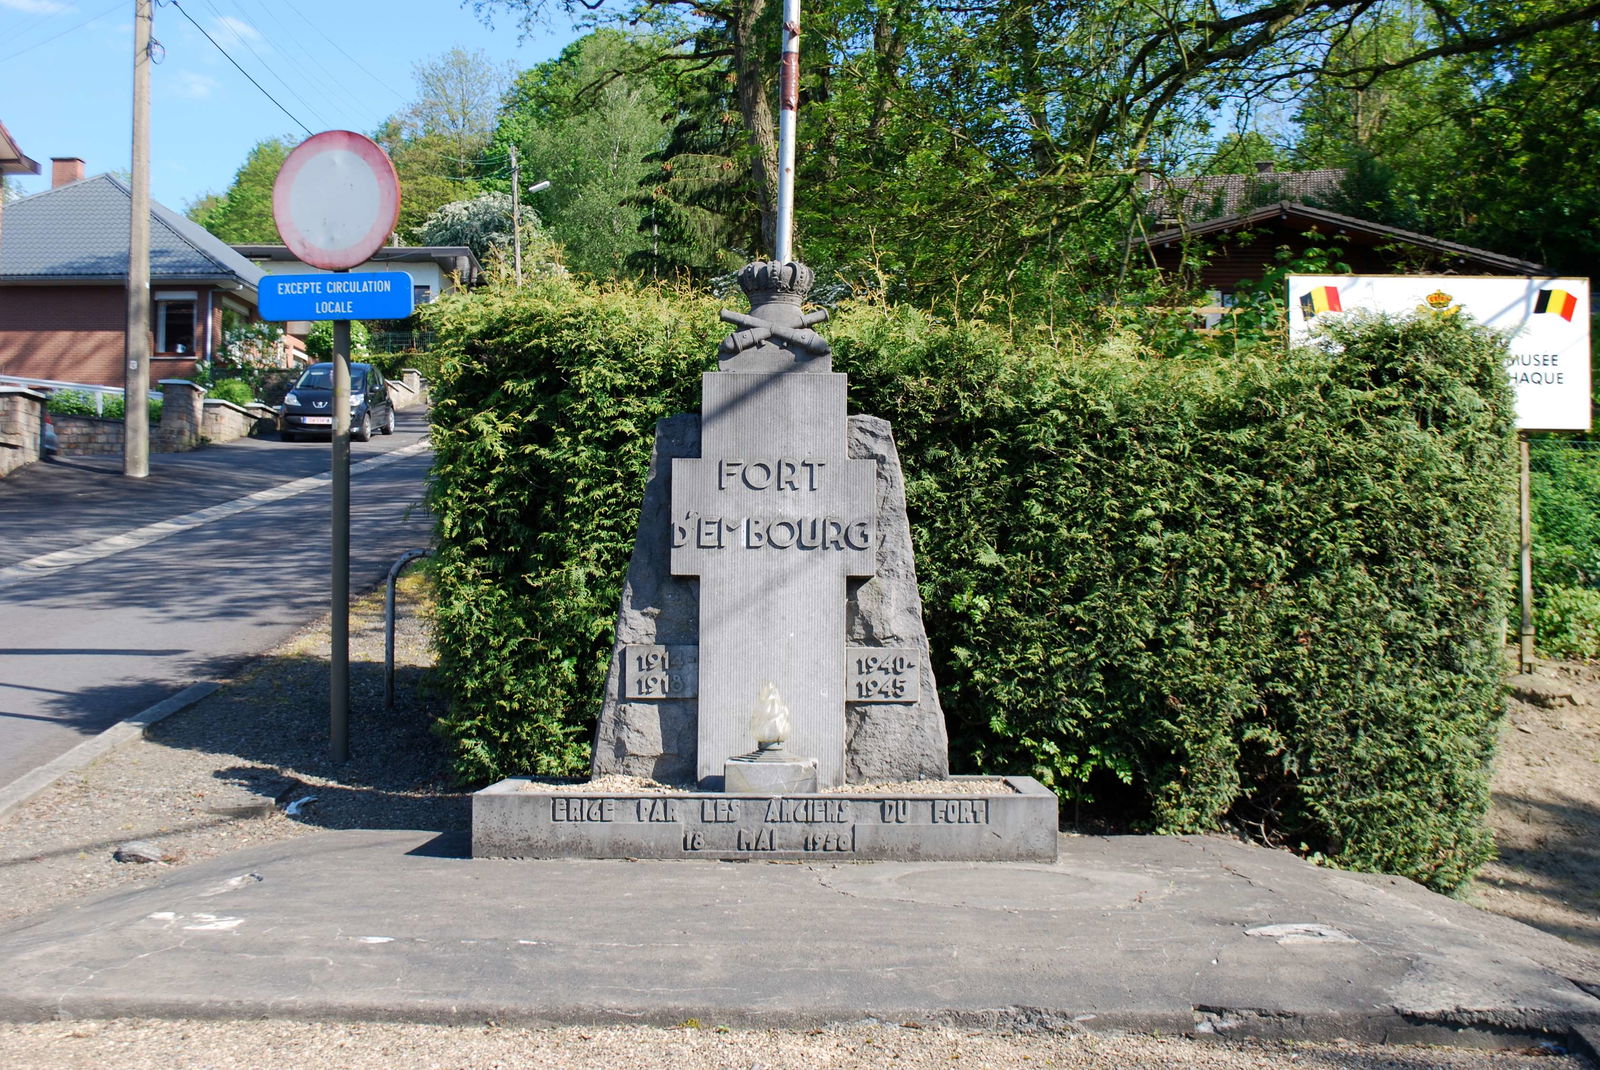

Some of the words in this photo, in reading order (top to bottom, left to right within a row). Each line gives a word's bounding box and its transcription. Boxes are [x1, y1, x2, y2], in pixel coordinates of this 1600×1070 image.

[278, 282, 322, 295] EXCEPTE
[326, 280, 391, 294] CIRCULATION
[315, 301, 353, 314] LOCALE
[1506, 371, 1564, 385] HAQUE
[718, 458, 825, 492] FORT
[671, 510, 872, 551] D'EMBOURG
[636, 674, 684, 696] 1918
[856, 678, 906, 699] 1945
[552, 799, 614, 822] ERIGE
[637, 799, 678, 822] PAR
[701, 799, 740, 822] LES
[764, 799, 850, 823] ANCIENS
[880, 799, 911, 823] DU
[931, 799, 989, 824] FORT
[683, 831, 706, 851] 18
[737, 827, 778, 851] MAI
[803, 832, 852, 851] 1950
